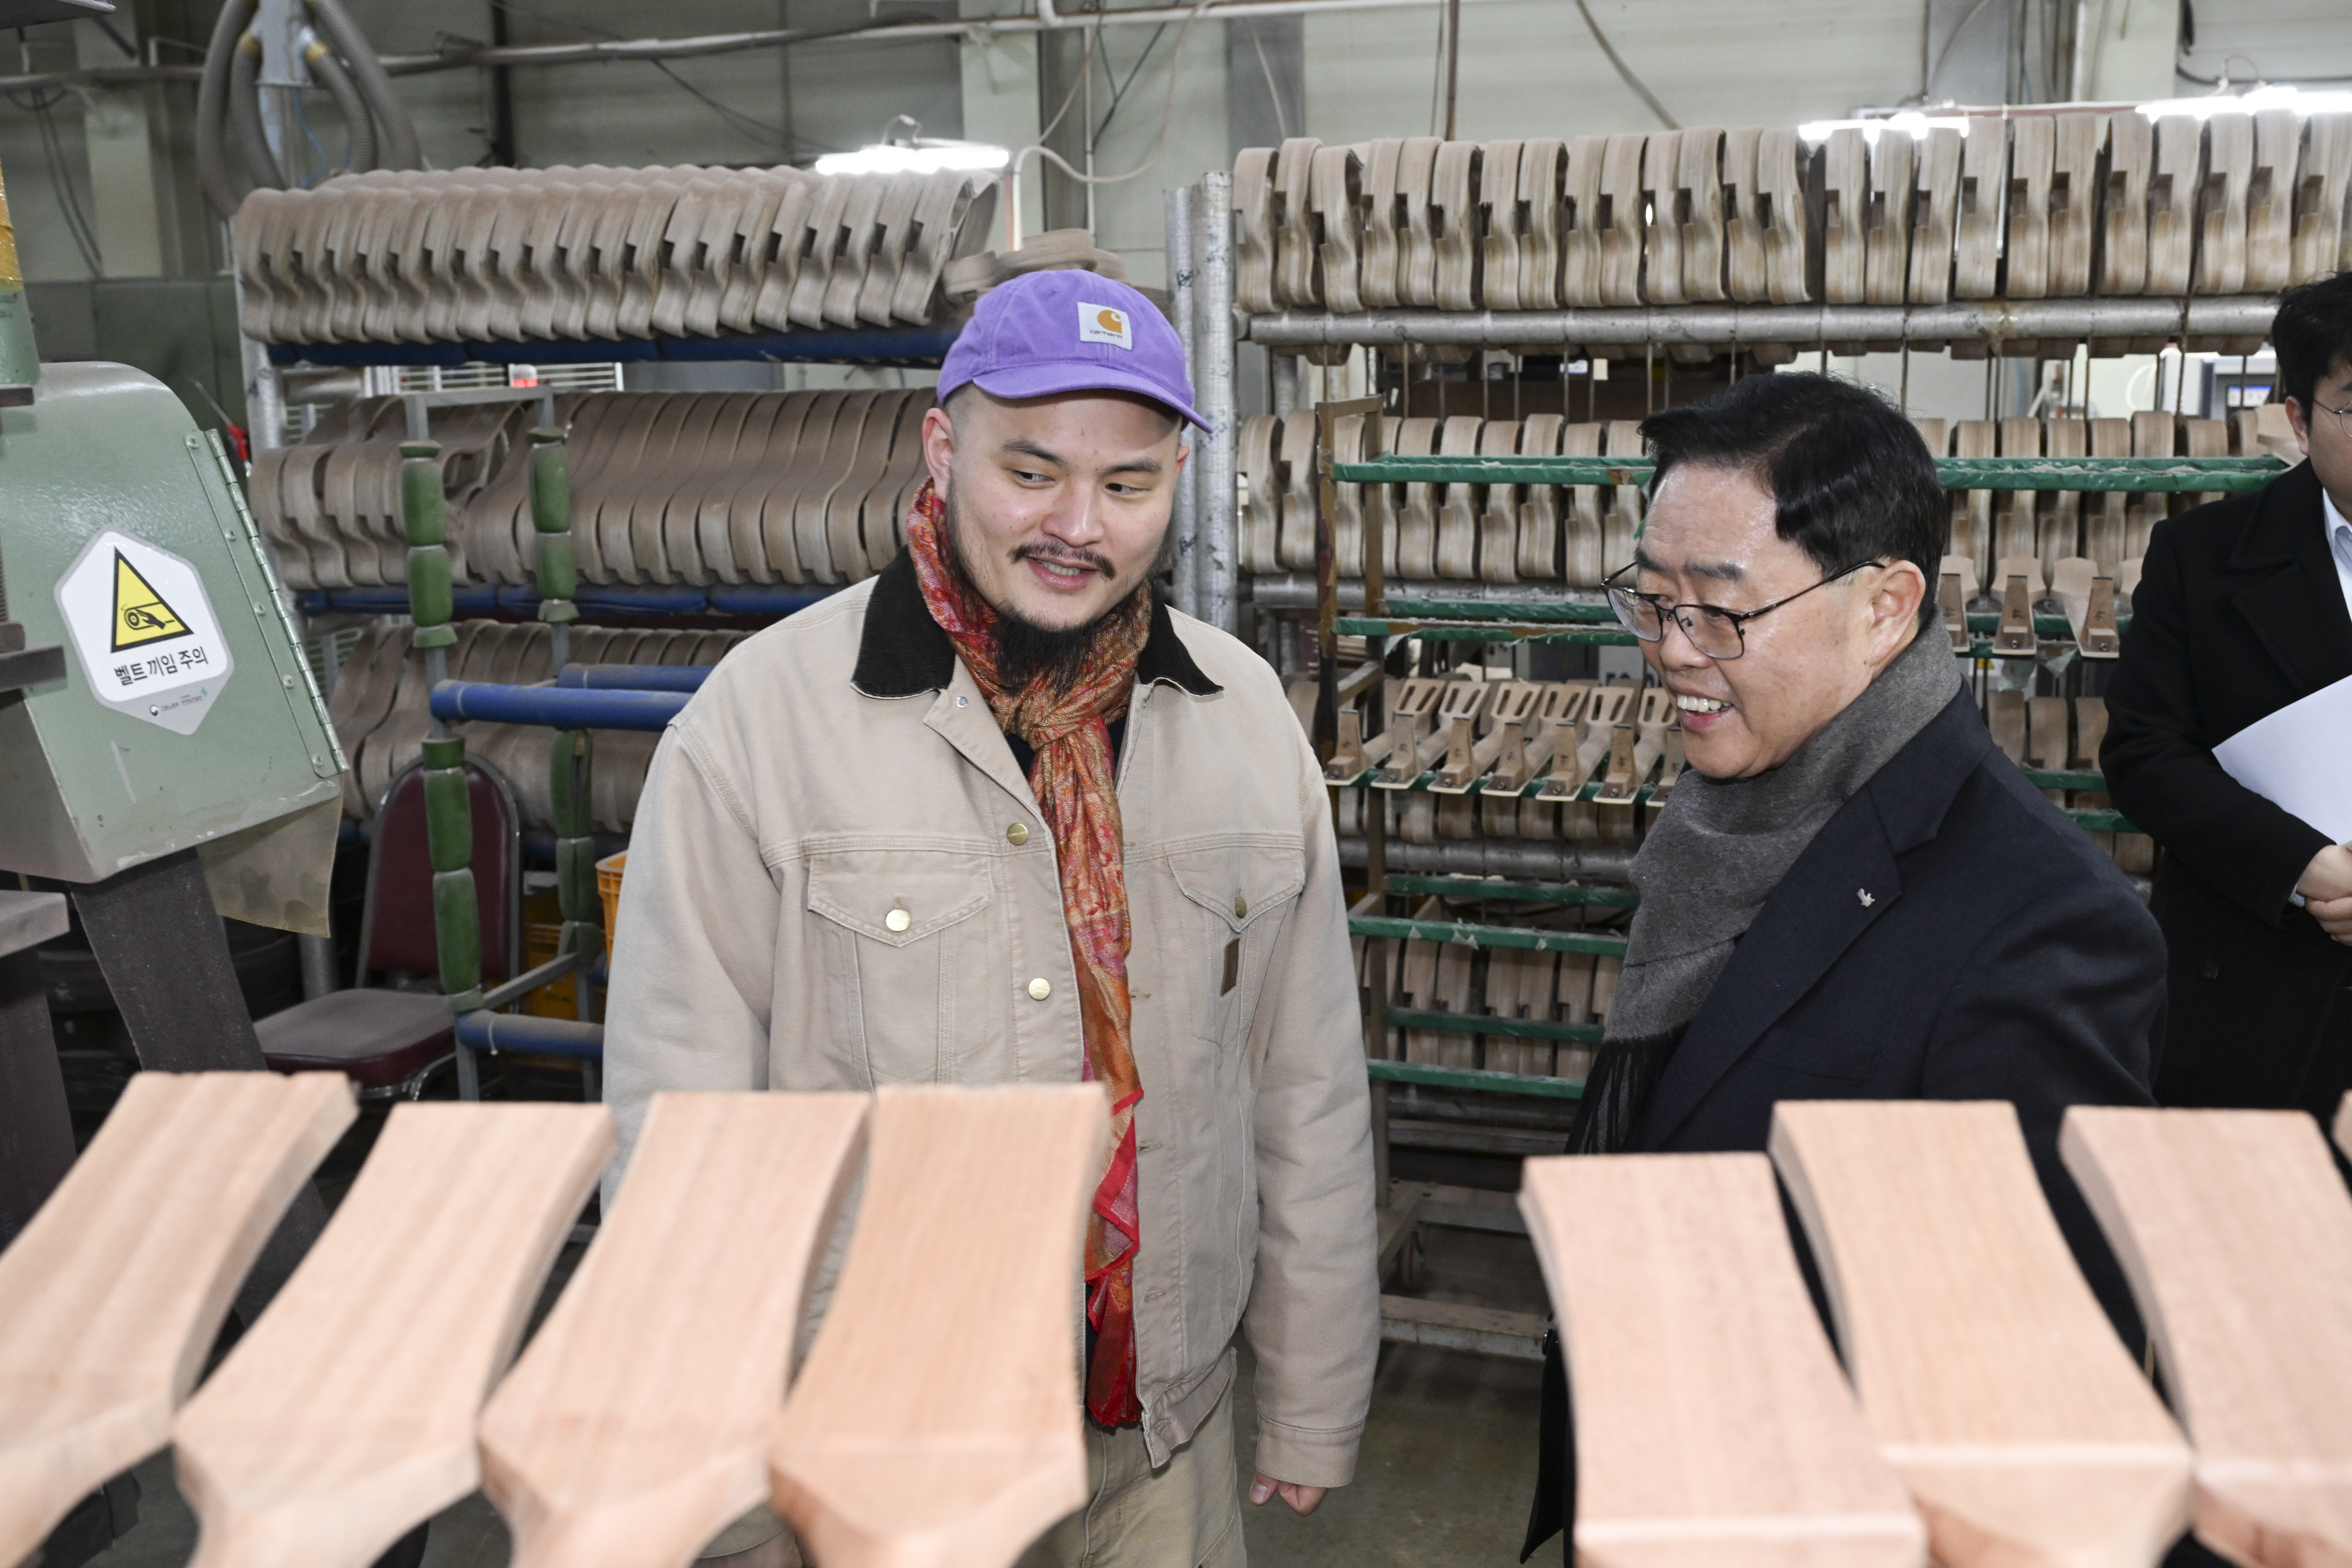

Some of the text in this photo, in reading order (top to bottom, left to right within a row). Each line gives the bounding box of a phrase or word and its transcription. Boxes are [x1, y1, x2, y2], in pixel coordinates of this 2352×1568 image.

[1090, 329, 1123, 339] carhartt
[114, 645, 209, 686] 벨트 끼임 주의
